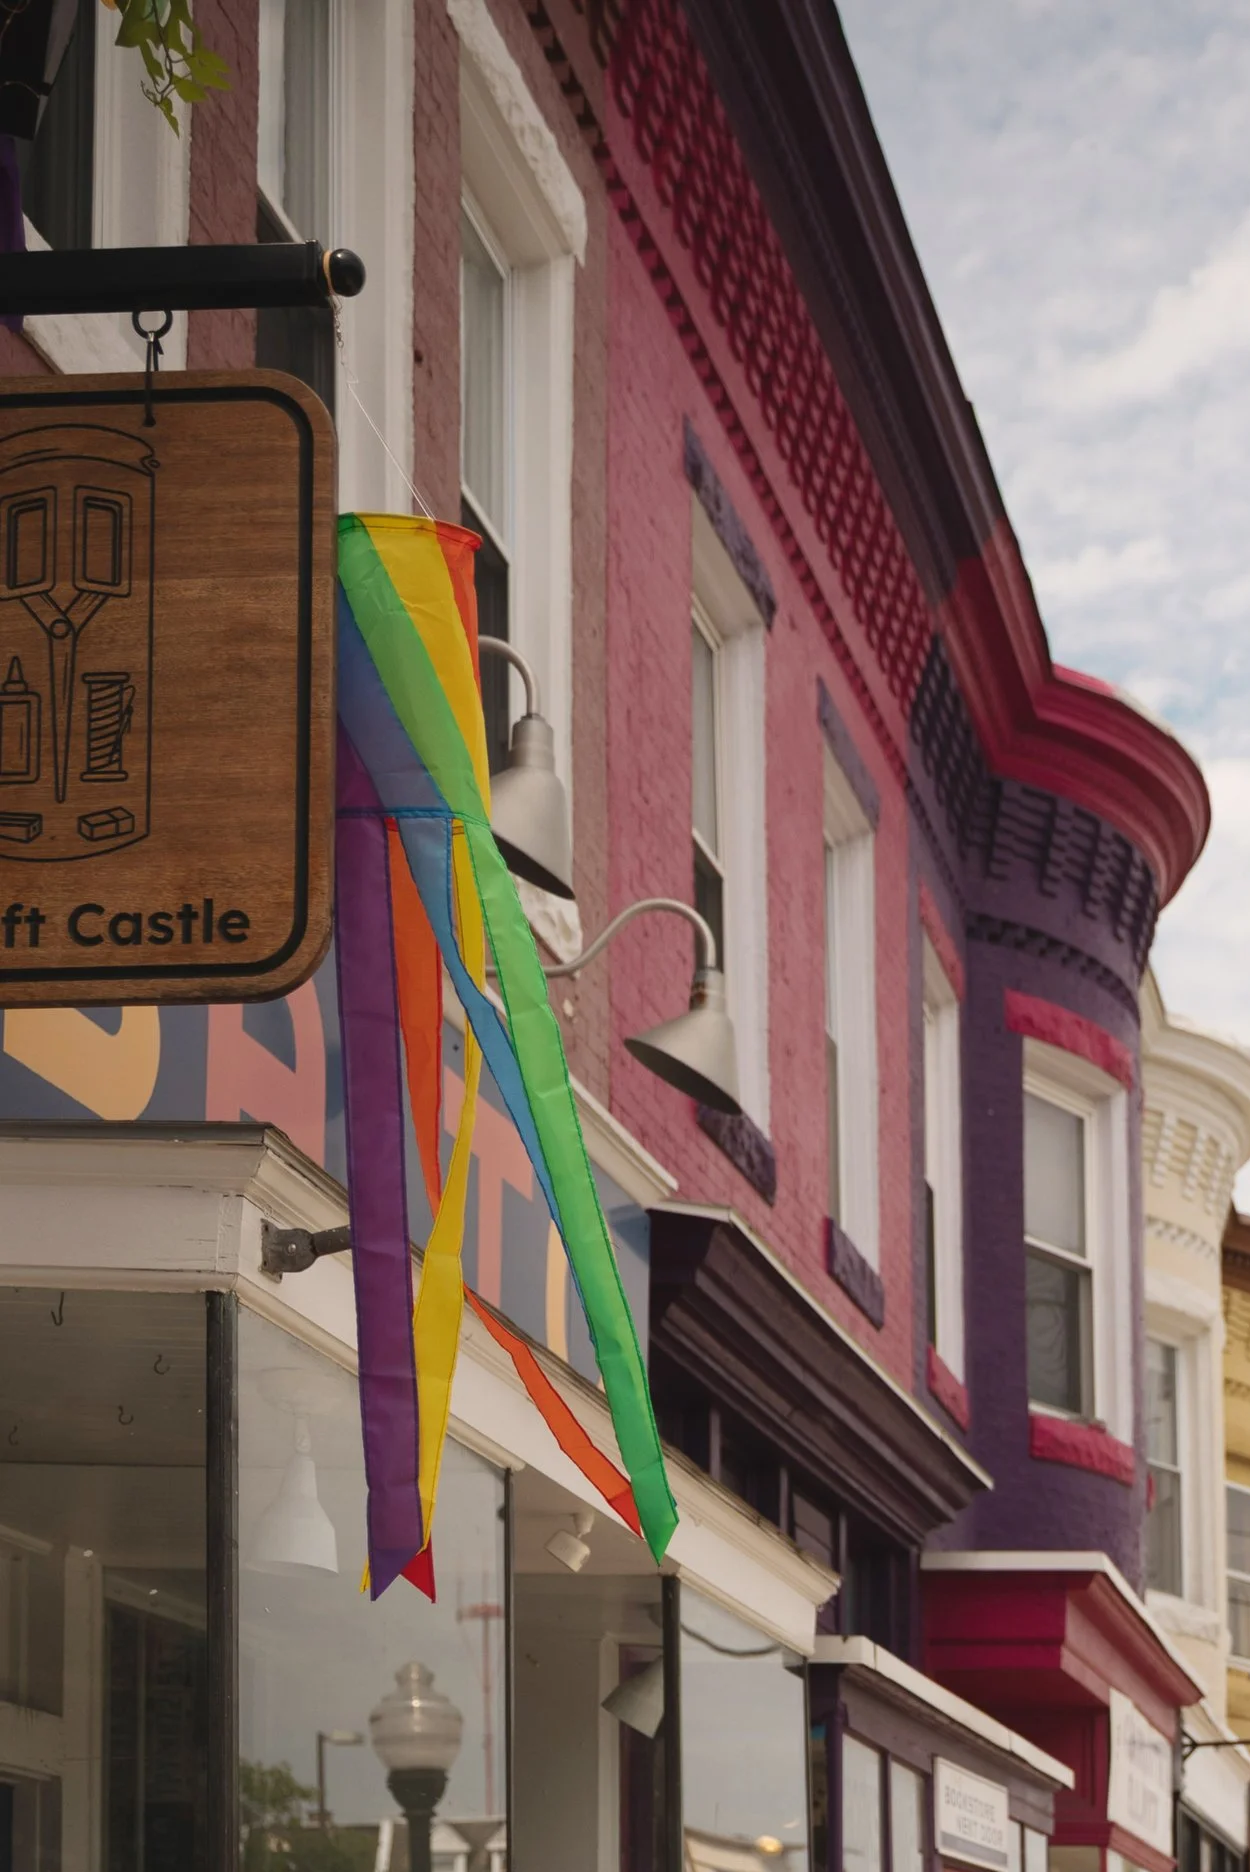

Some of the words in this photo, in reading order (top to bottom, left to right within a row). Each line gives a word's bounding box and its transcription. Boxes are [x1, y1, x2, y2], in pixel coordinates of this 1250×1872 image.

[67, 898, 250, 947] Castle
[944, 1784, 996, 1823] BOOKSTORE
[956, 1813, 978, 1840] NEXT
[980, 1823, 1003, 1847] DOOR
